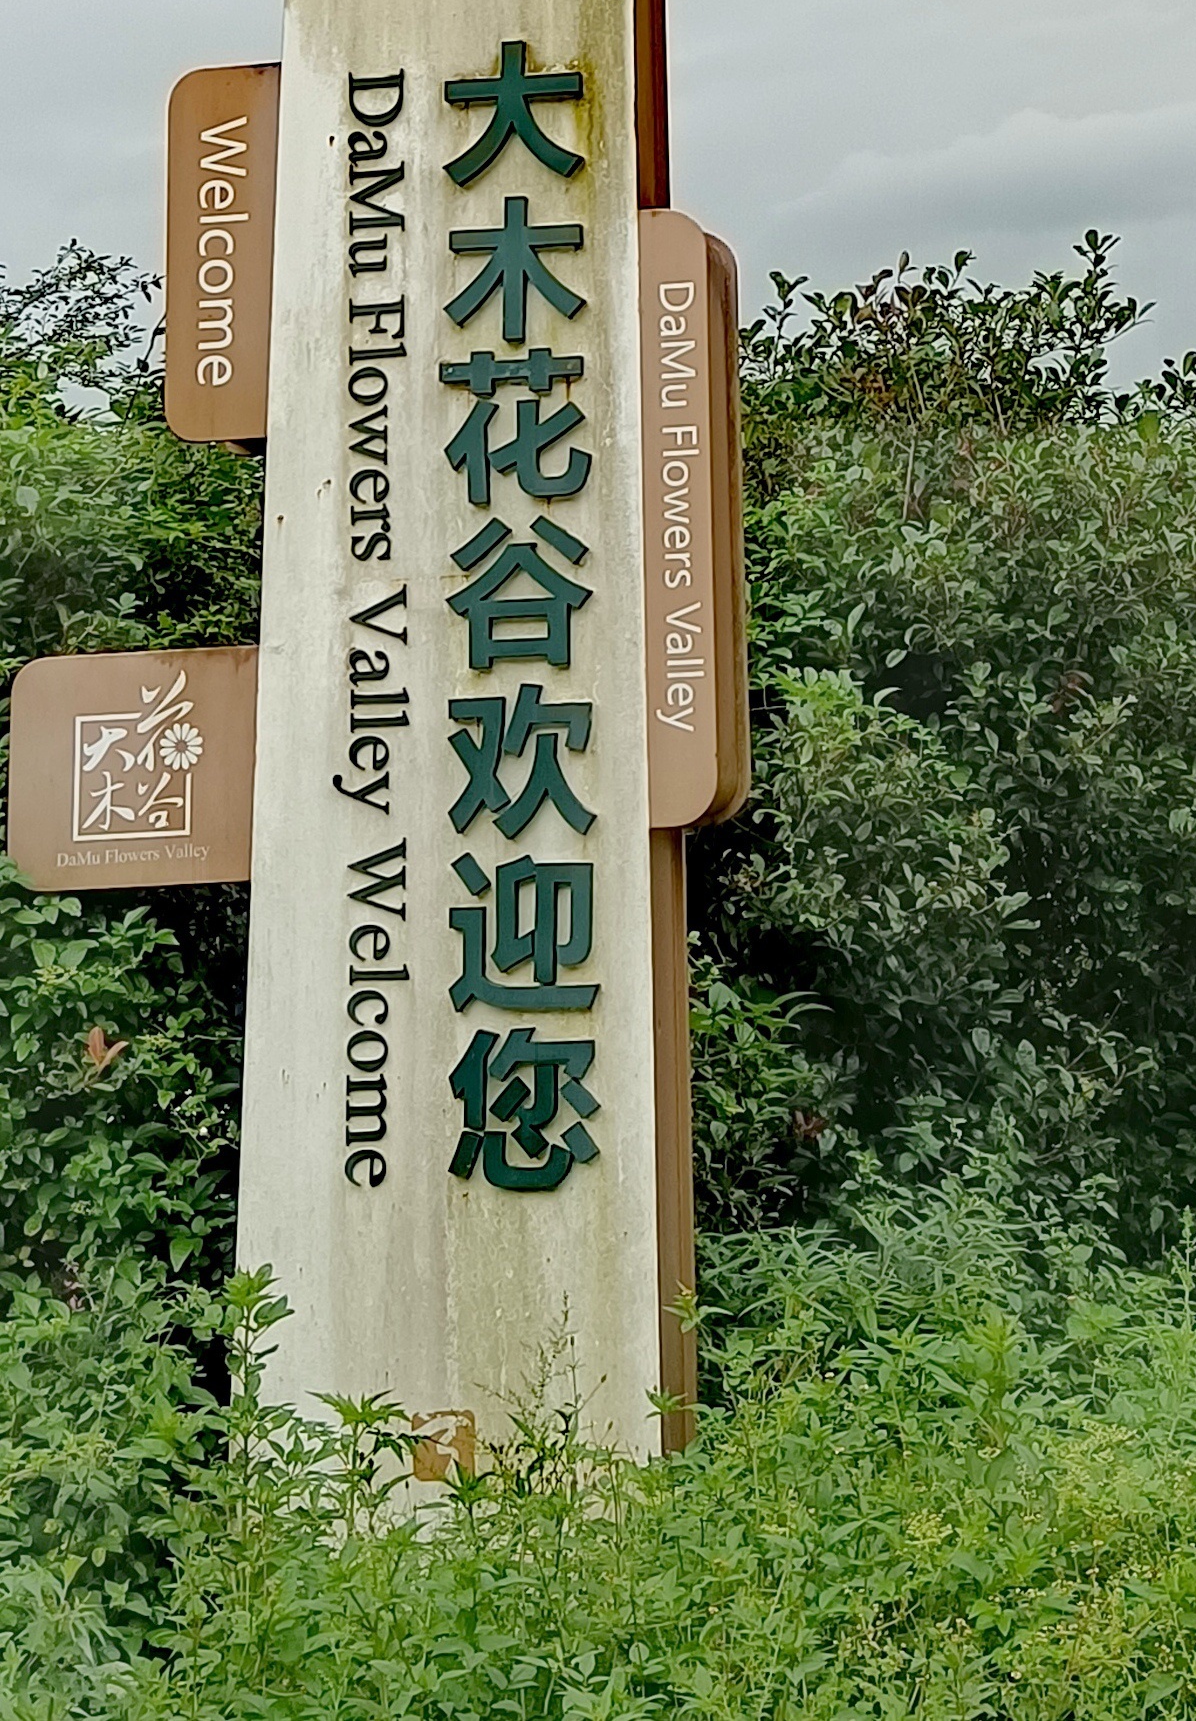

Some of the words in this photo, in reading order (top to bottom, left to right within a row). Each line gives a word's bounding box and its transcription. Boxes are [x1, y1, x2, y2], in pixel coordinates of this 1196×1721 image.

[196, 116, 249, 387] Welcome
[347, 69, 406, 279] DaMu
[347, 294, 406, 562] Flowers
[657, 281, 696, 409] DaMu
[439, 40, 598, 1194] 大木花谷欢迎您
[661, 424, 700, 590] Flowers
[331, 584, 409, 817] Valley
[655, 602, 705, 732] Valley
[57, 851, 101, 867] DaMu
[105, 847, 160, 864] Flowers
[164, 843, 210, 860] Valley
[345, 837, 409, 1189] Welcome
